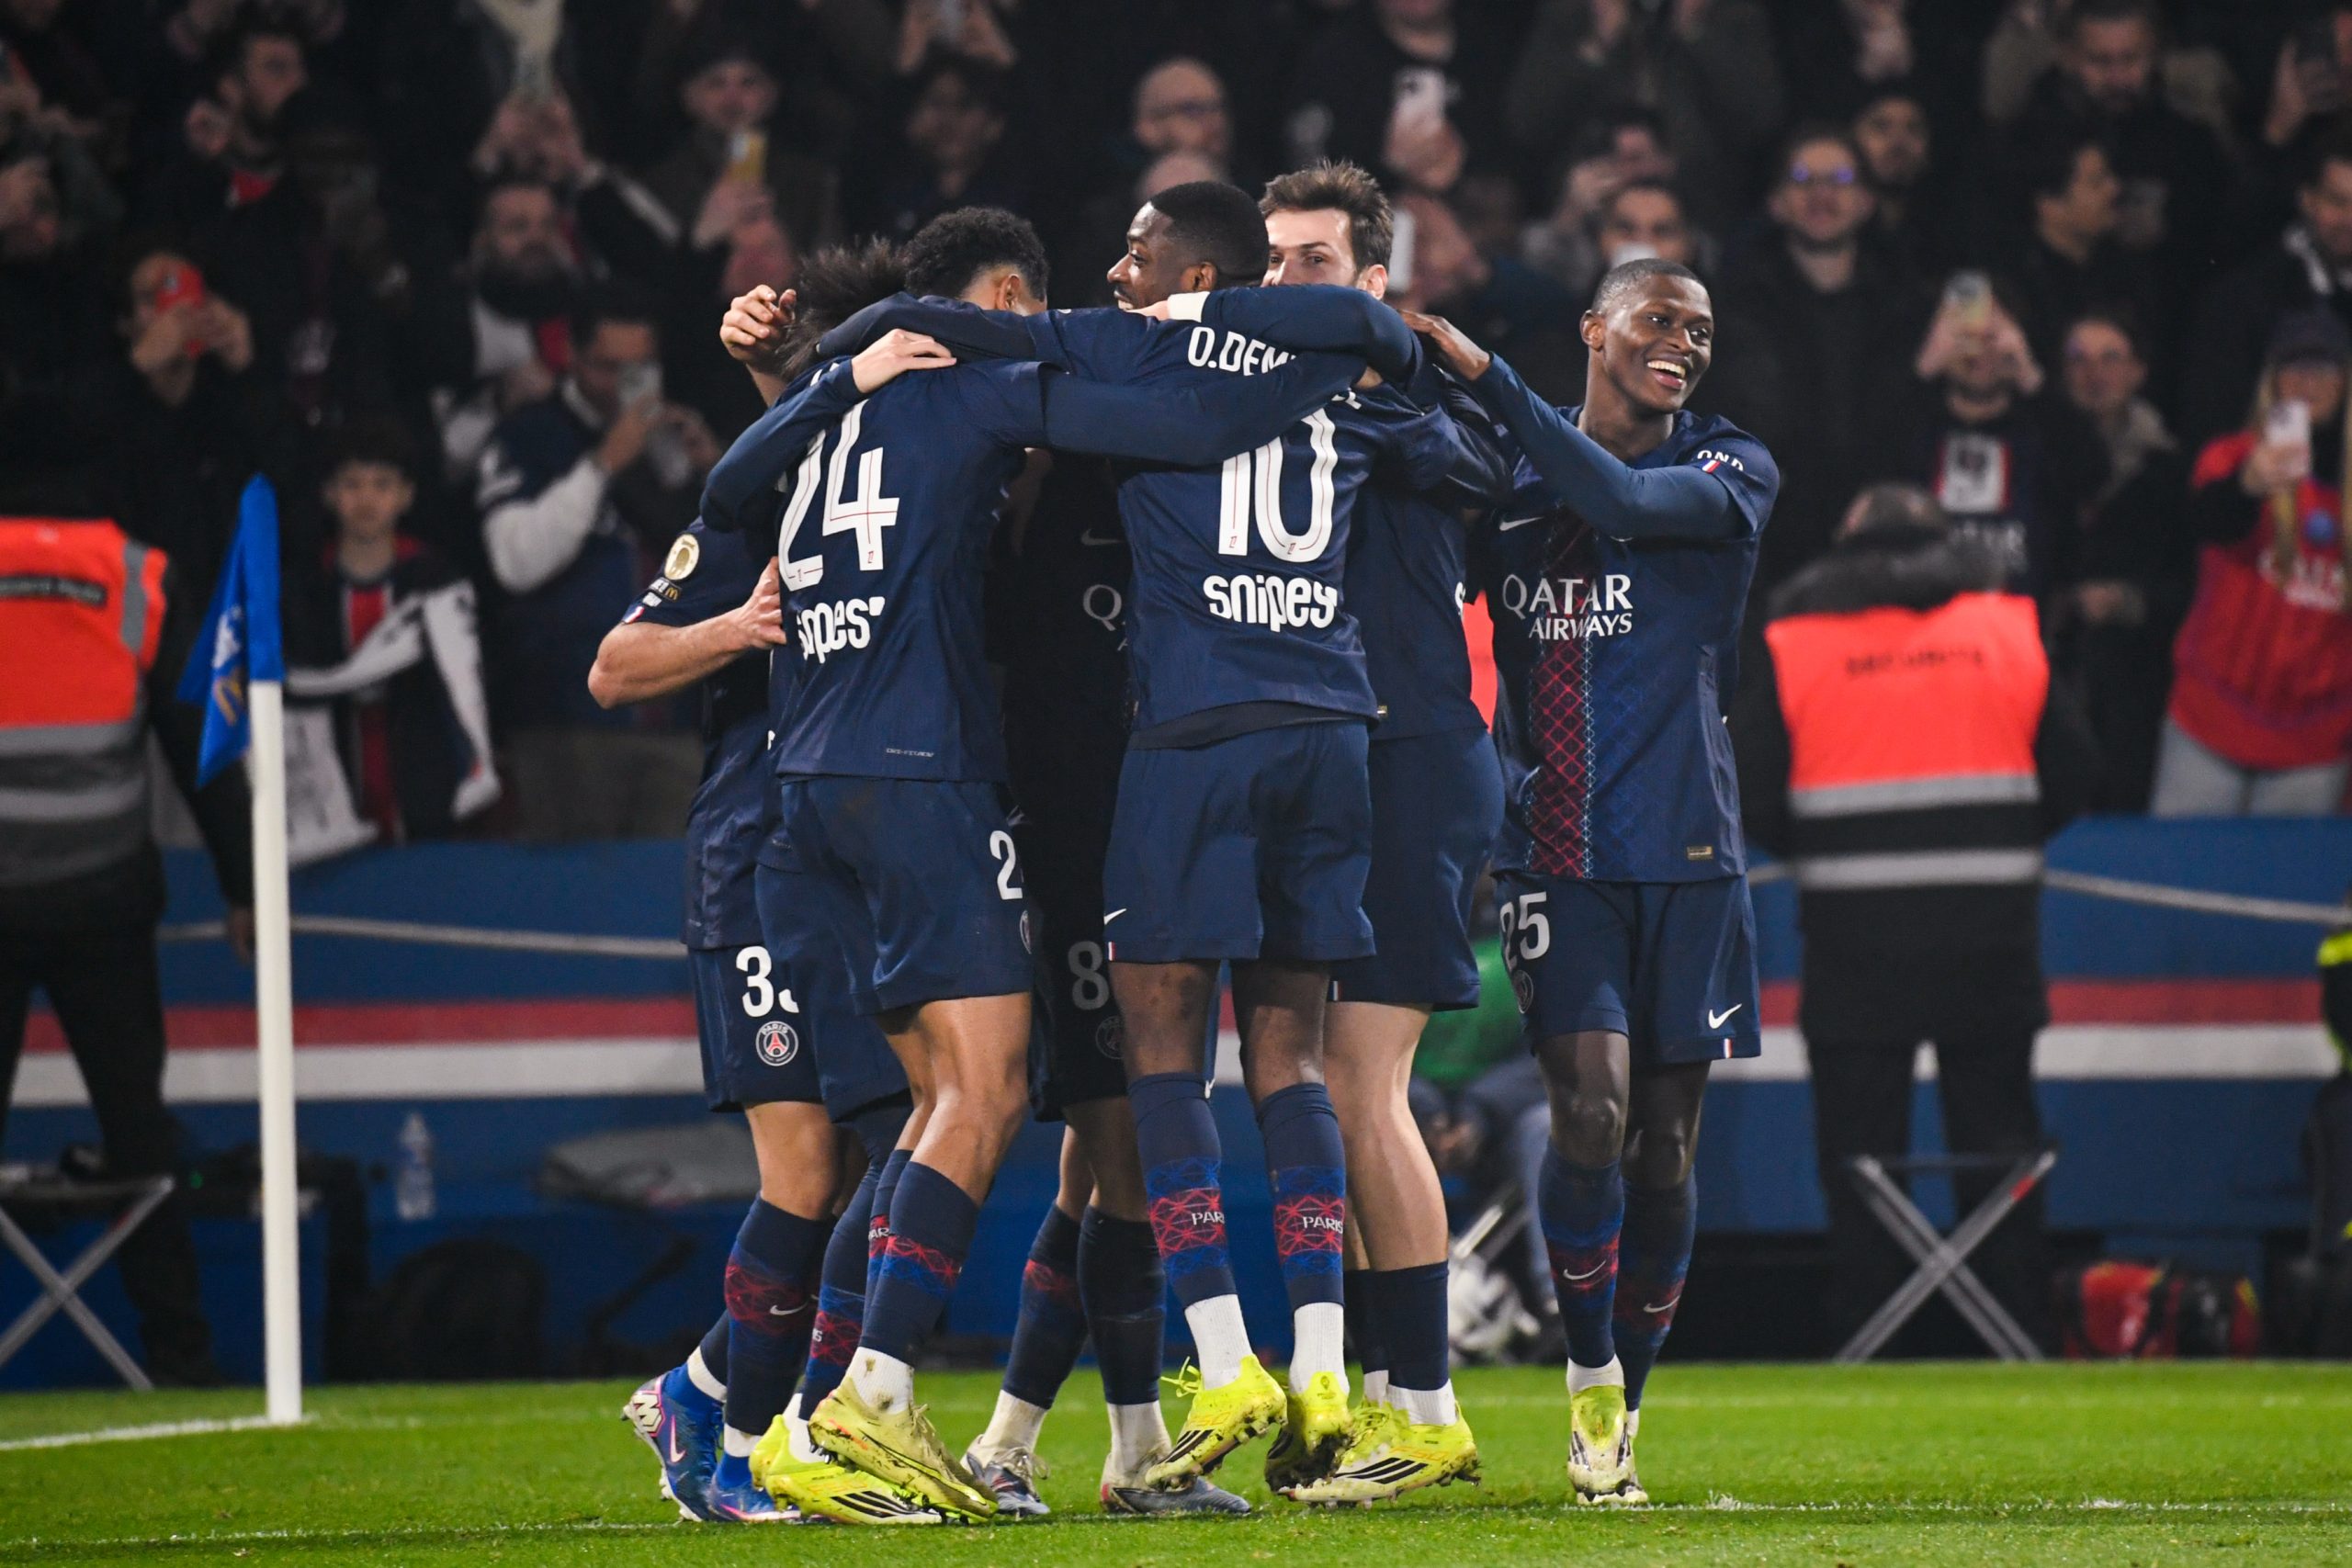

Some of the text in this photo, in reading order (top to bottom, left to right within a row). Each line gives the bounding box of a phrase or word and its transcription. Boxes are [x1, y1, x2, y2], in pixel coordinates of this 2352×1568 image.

[1188, 327, 1296, 376] O.DEM
[775, 399, 900, 592] 24
[1218, 408, 1338, 563] 10
[1502, 574, 1634, 620] QATAR
[1529, 613, 1633, 641] AIRWAYS
[989, 830, 1023, 900] 2
[1500, 891, 1551, 974] 25
[736, 946, 799, 1017] 3
[1069, 941, 1110, 1010] 8
[1192, 1212, 1225, 1225] PAR
[1303, 1216, 1343, 1234] PARIS
